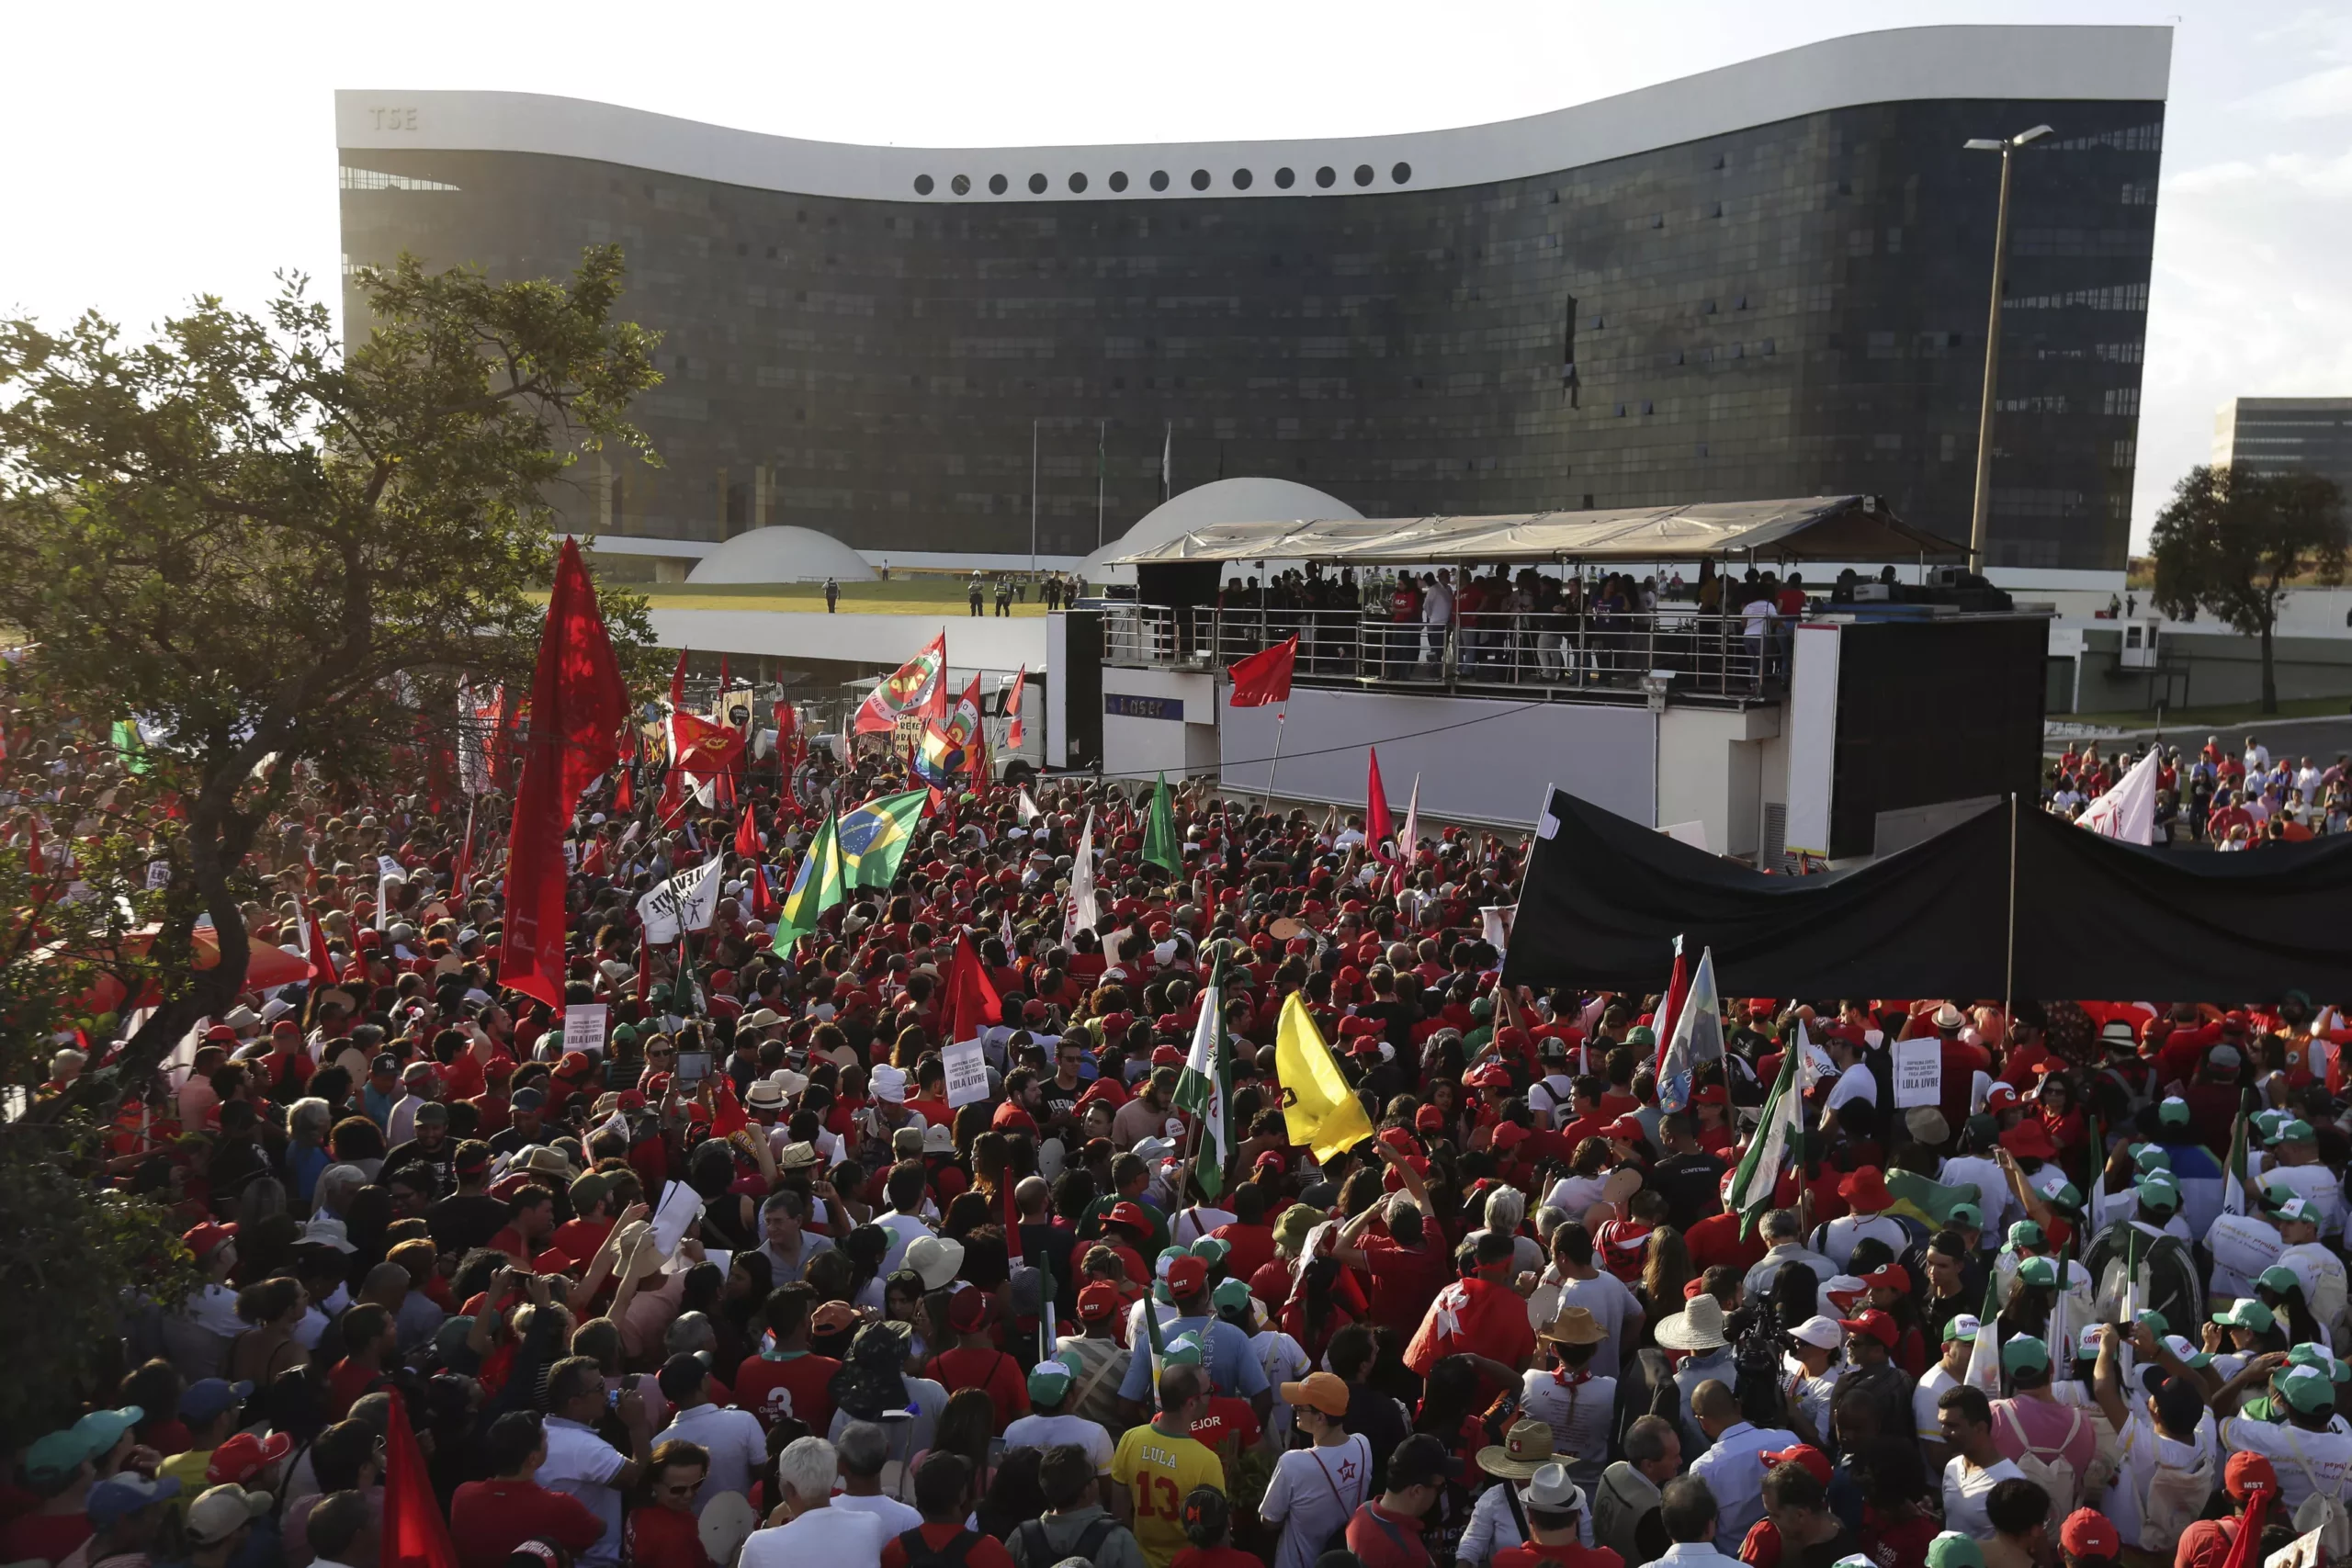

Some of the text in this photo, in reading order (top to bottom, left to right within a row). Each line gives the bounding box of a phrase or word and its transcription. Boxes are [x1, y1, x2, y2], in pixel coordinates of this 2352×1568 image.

[368, 107, 418, 130] TSE
[568, 1033, 603, 1044] LULA LIVRE
[950, 1073, 985, 1090] LULA LIVRE
[1903, 1077, 1939, 1089] LULA LIVRE
[1173, 1279, 1188, 1288] MST
[1084, 1303, 1099, 1312] MST
[759, 1405, 778, 1415] Chapa
[1188, 1416, 1221, 1432] EJOR
[1141, 1445, 1177, 1469] LULA
[1341, 1466, 1354, 1478] PT
[1136, 1471, 1182, 1521] 13
